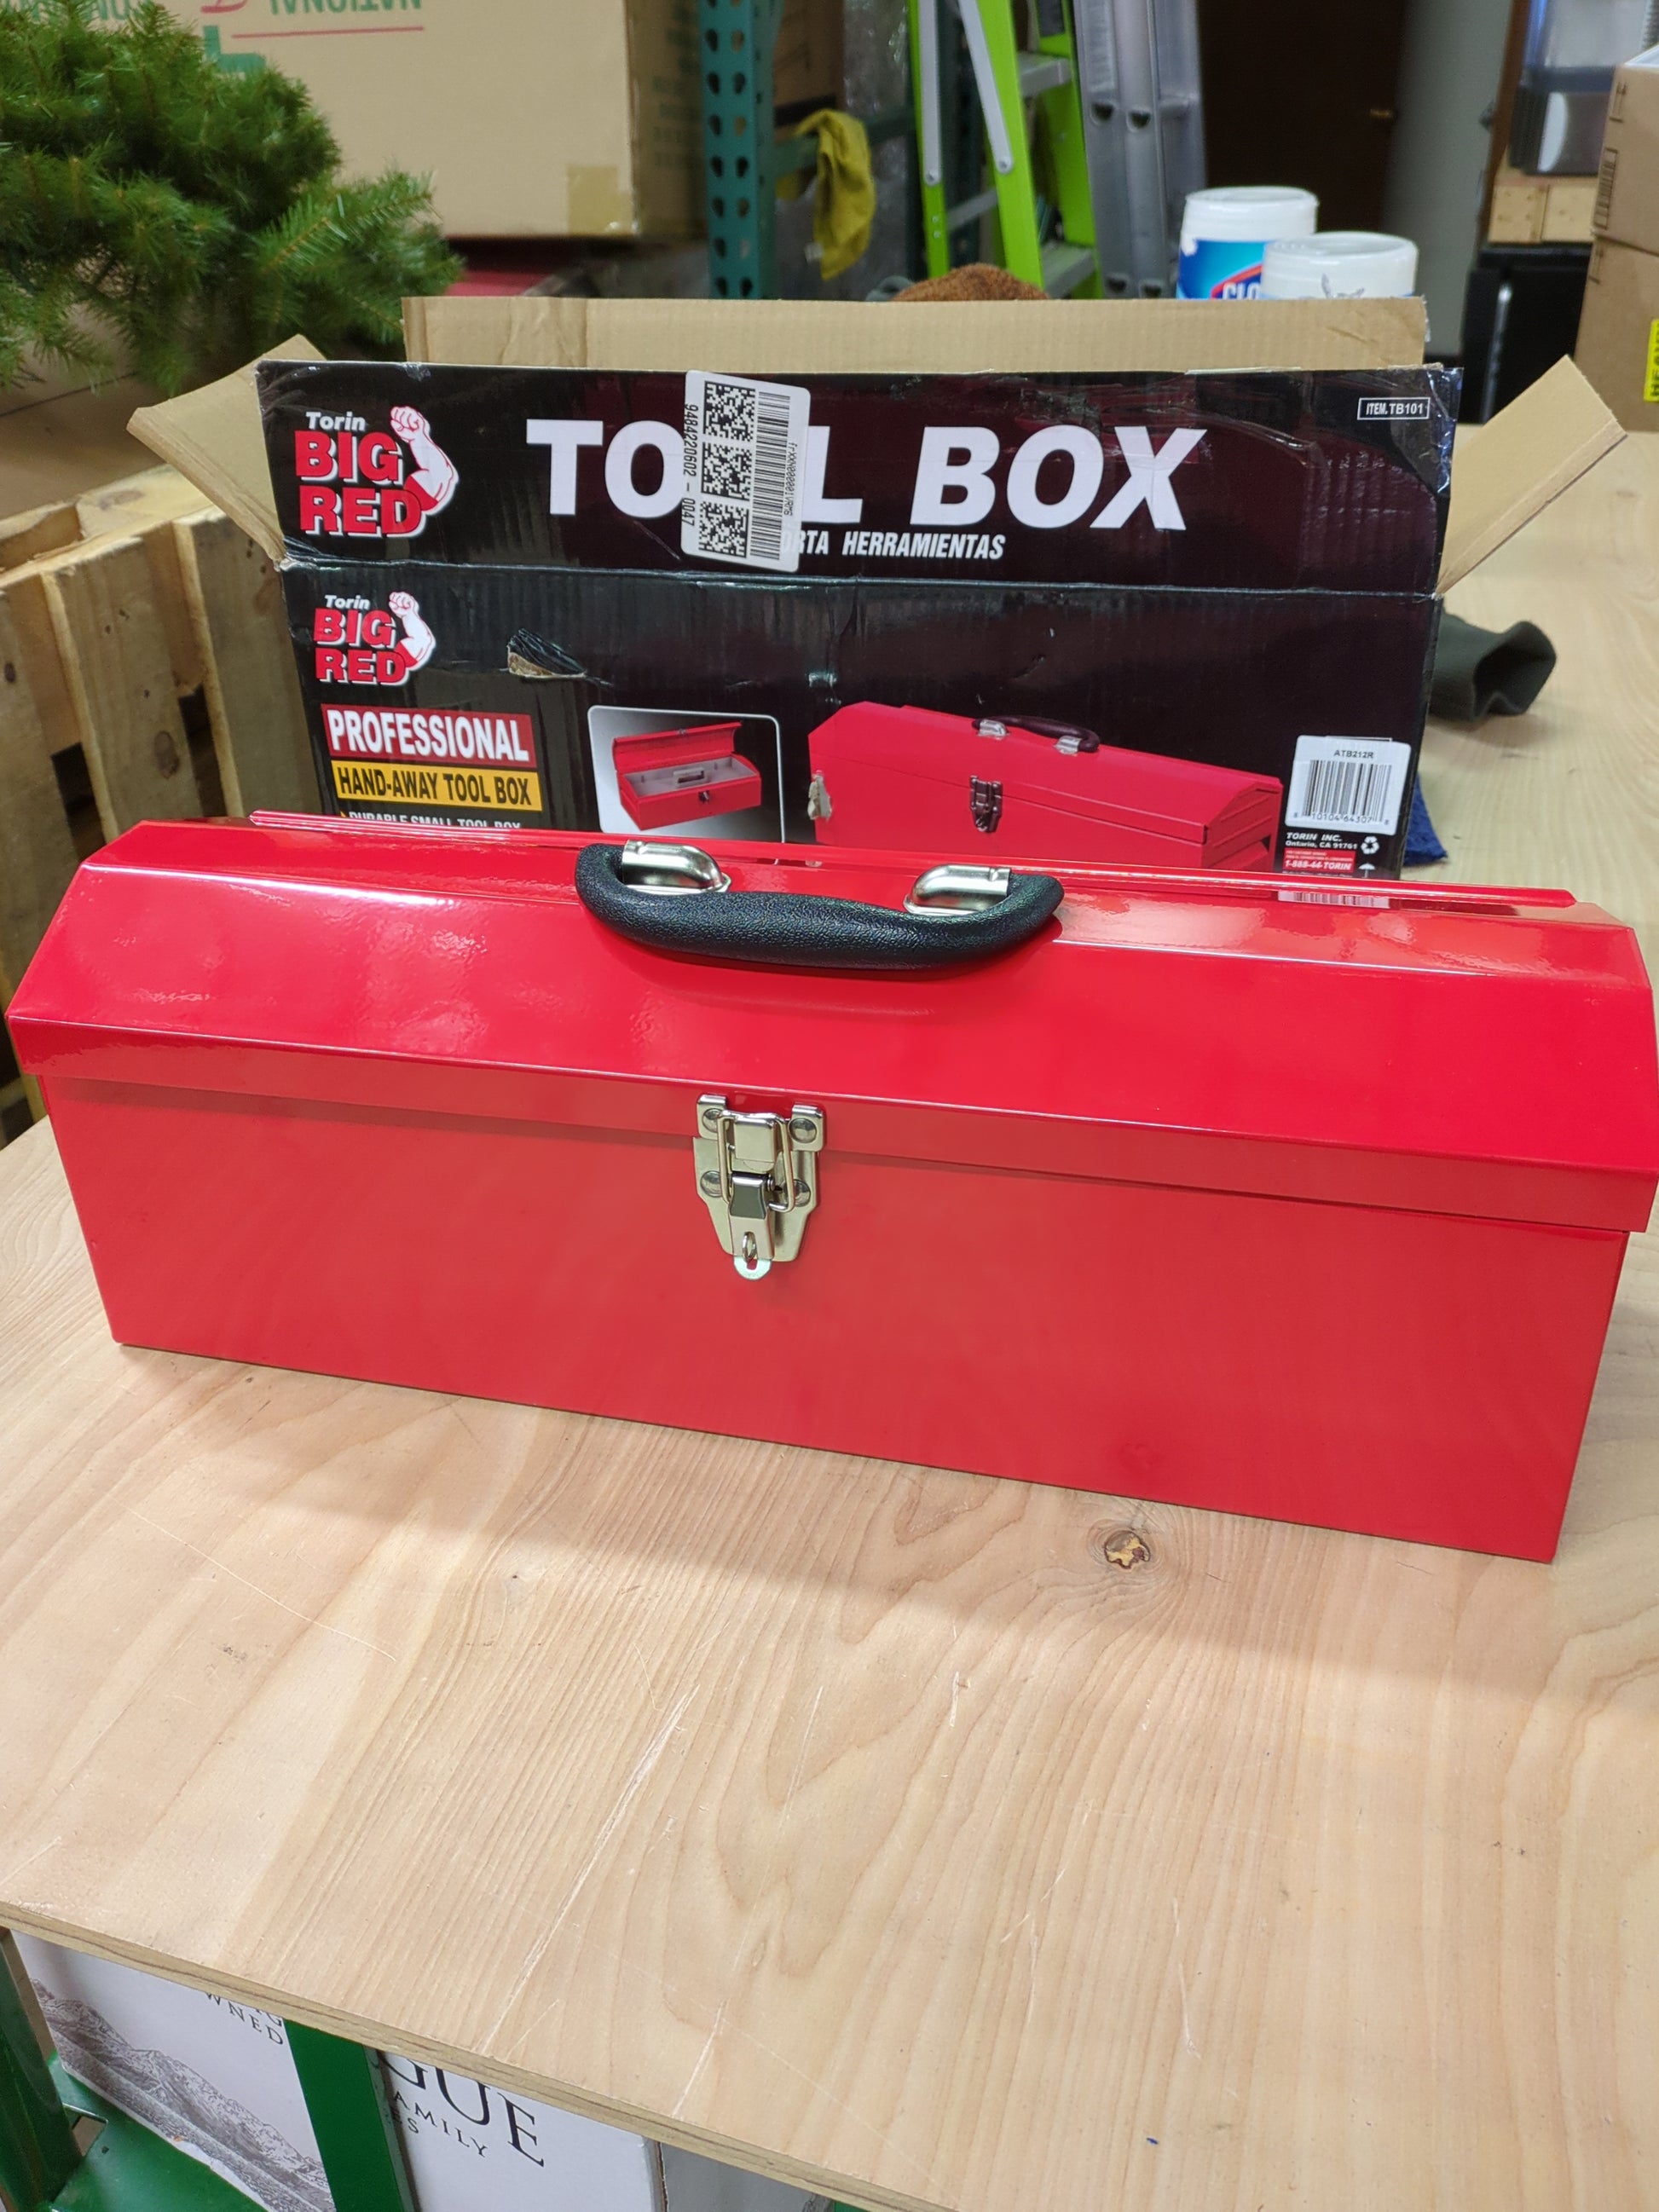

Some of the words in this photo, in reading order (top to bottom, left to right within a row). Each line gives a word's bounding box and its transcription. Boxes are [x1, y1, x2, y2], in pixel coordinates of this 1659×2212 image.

[305, 411, 367, 431] Torin
[683, 403, 698, 476] 9484220602
[294, 430, 404, 486] BIG
[526, 419, 863, 523] TOL
[910, 424, 1208, 530] BOX
[299, 485, 426, 538] RED
[682, 498, 696, 527] 0047
[841, 531, 1006, 560] HERRAMIENTAS
[324, 595, 371, 609] Torin
[314, 608, 396, 649] BIG
[315, 648, 410, 686] RED
[327, 709, 529, 762] PROFESSIONAL
[1333, 749, 1374, 759] ATB212R
[337, 766, 438, 800] HAND-AWAY
[443, 773, 491, 803] TOOL
[494, 776, 532, 806] BOX
[1285, 840, 1317, 849] Ontario,
[1286, 832, 1317, 840] TORIN
[1321, 834, 1343, 842] INC.
